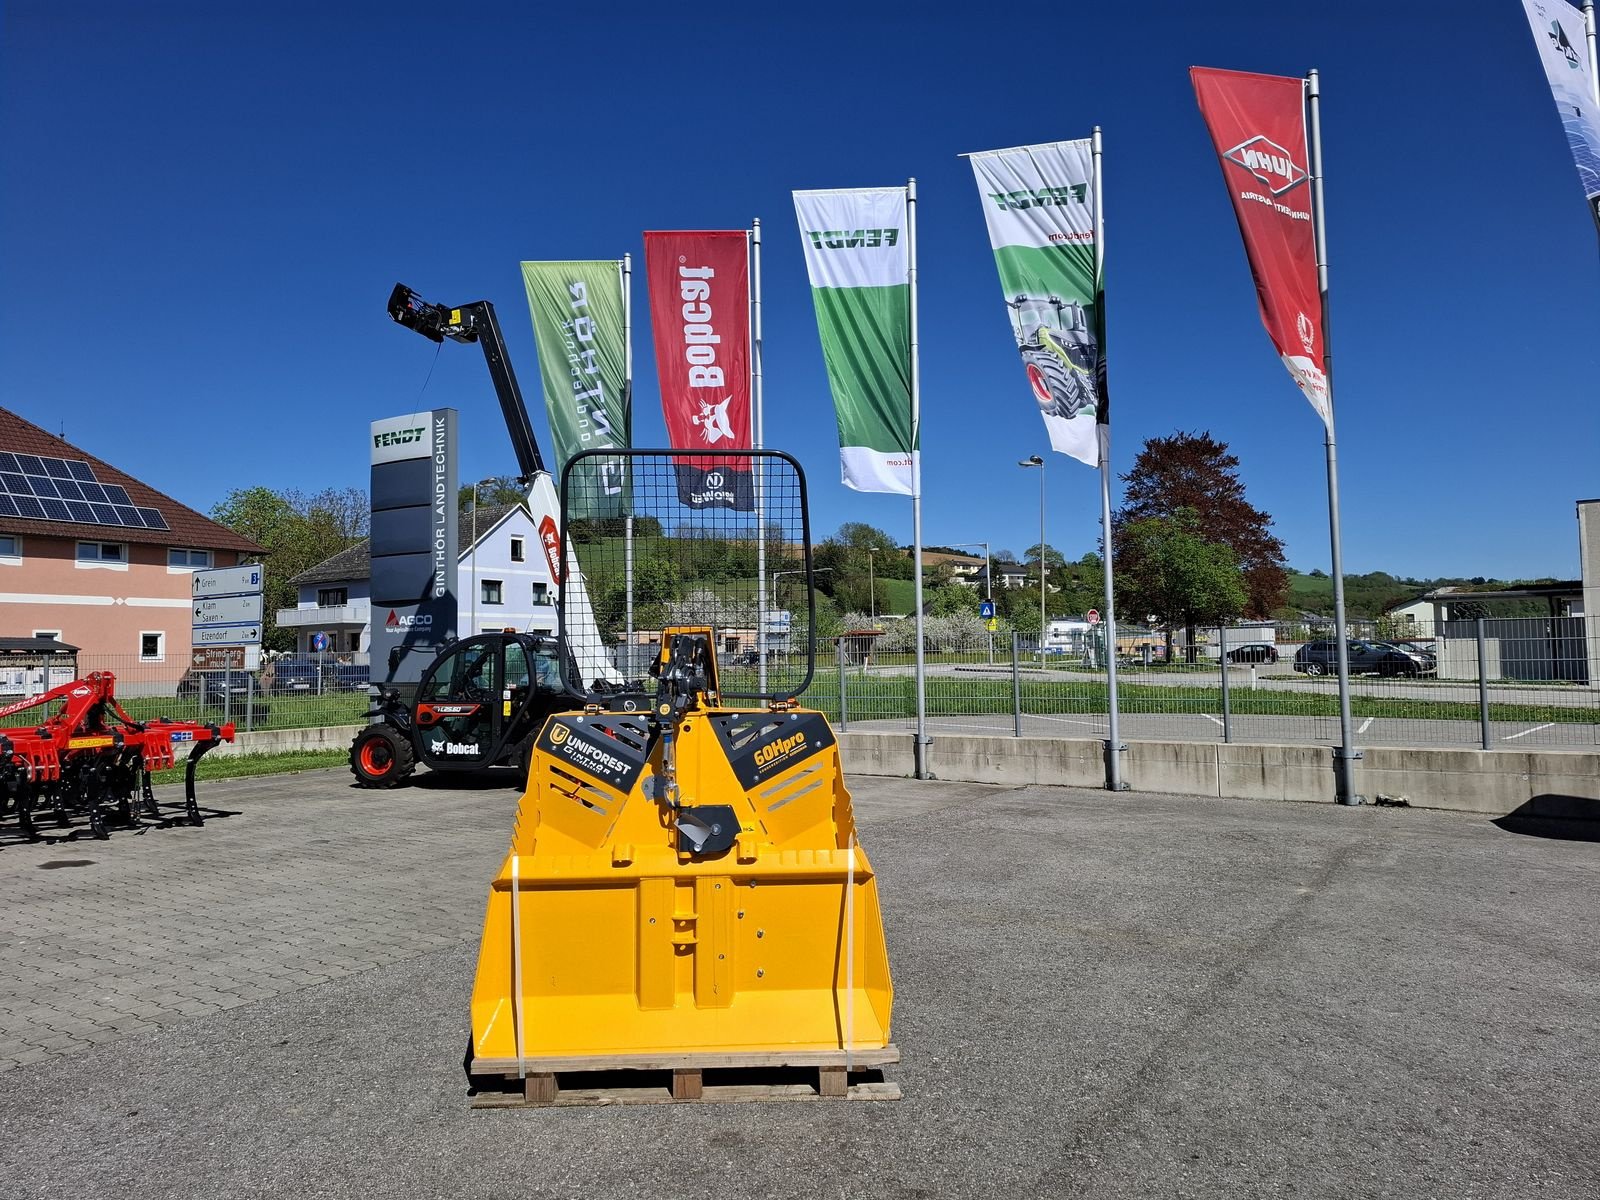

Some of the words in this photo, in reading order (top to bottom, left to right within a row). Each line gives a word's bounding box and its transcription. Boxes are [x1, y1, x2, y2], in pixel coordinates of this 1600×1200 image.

[373, 427, 426, 448] FENDT
[435, 417, 445, 523] LANDTECHNIK
[434, 528, 445, 597] GINTHÖR
[201, 579, 217, 588] Grein
[252, 574, 257, 583] 3
[202, 602, 216, 610] Klam
[202, 614, 218, 622] Saxen
[399, 614, 432, 625] AGCO
[201, 631, 228, 640] Eizendorf
[446, 742, 480, 755] Bobcat
[566, 735, 632, 775] UNIFOREST
[753, 732, 805, 766] 60Hpro
